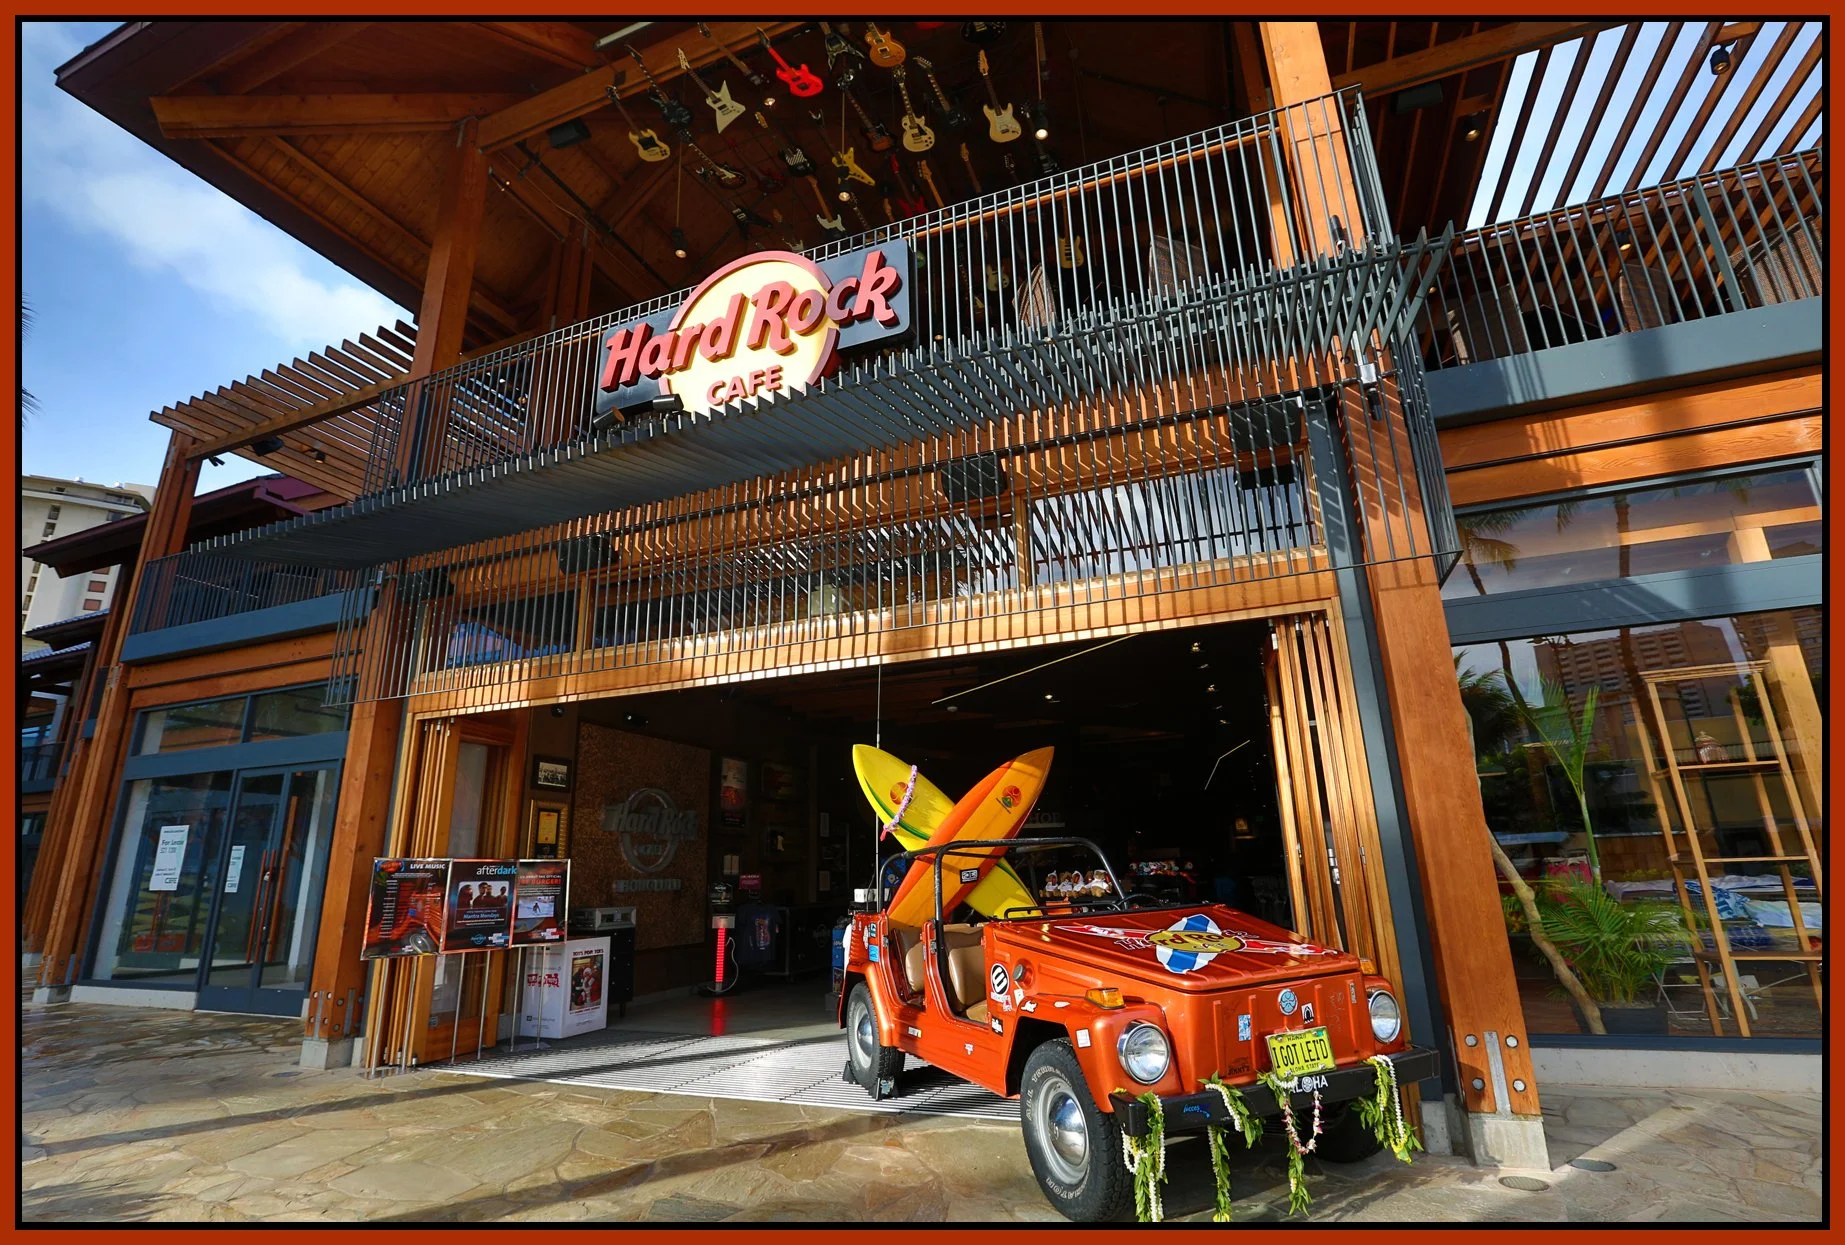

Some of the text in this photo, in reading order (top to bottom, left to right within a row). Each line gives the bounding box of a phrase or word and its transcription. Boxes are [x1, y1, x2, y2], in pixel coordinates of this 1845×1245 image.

[600, 250, 902, 392] Hard Rock
[706, 365, 784, 406] CAFE
[1272, 1047, 1281, 1069] I
[1279, 1043, 1302, 1067] GOT
[1300, 1038, 1329, 1064] LEI'D
